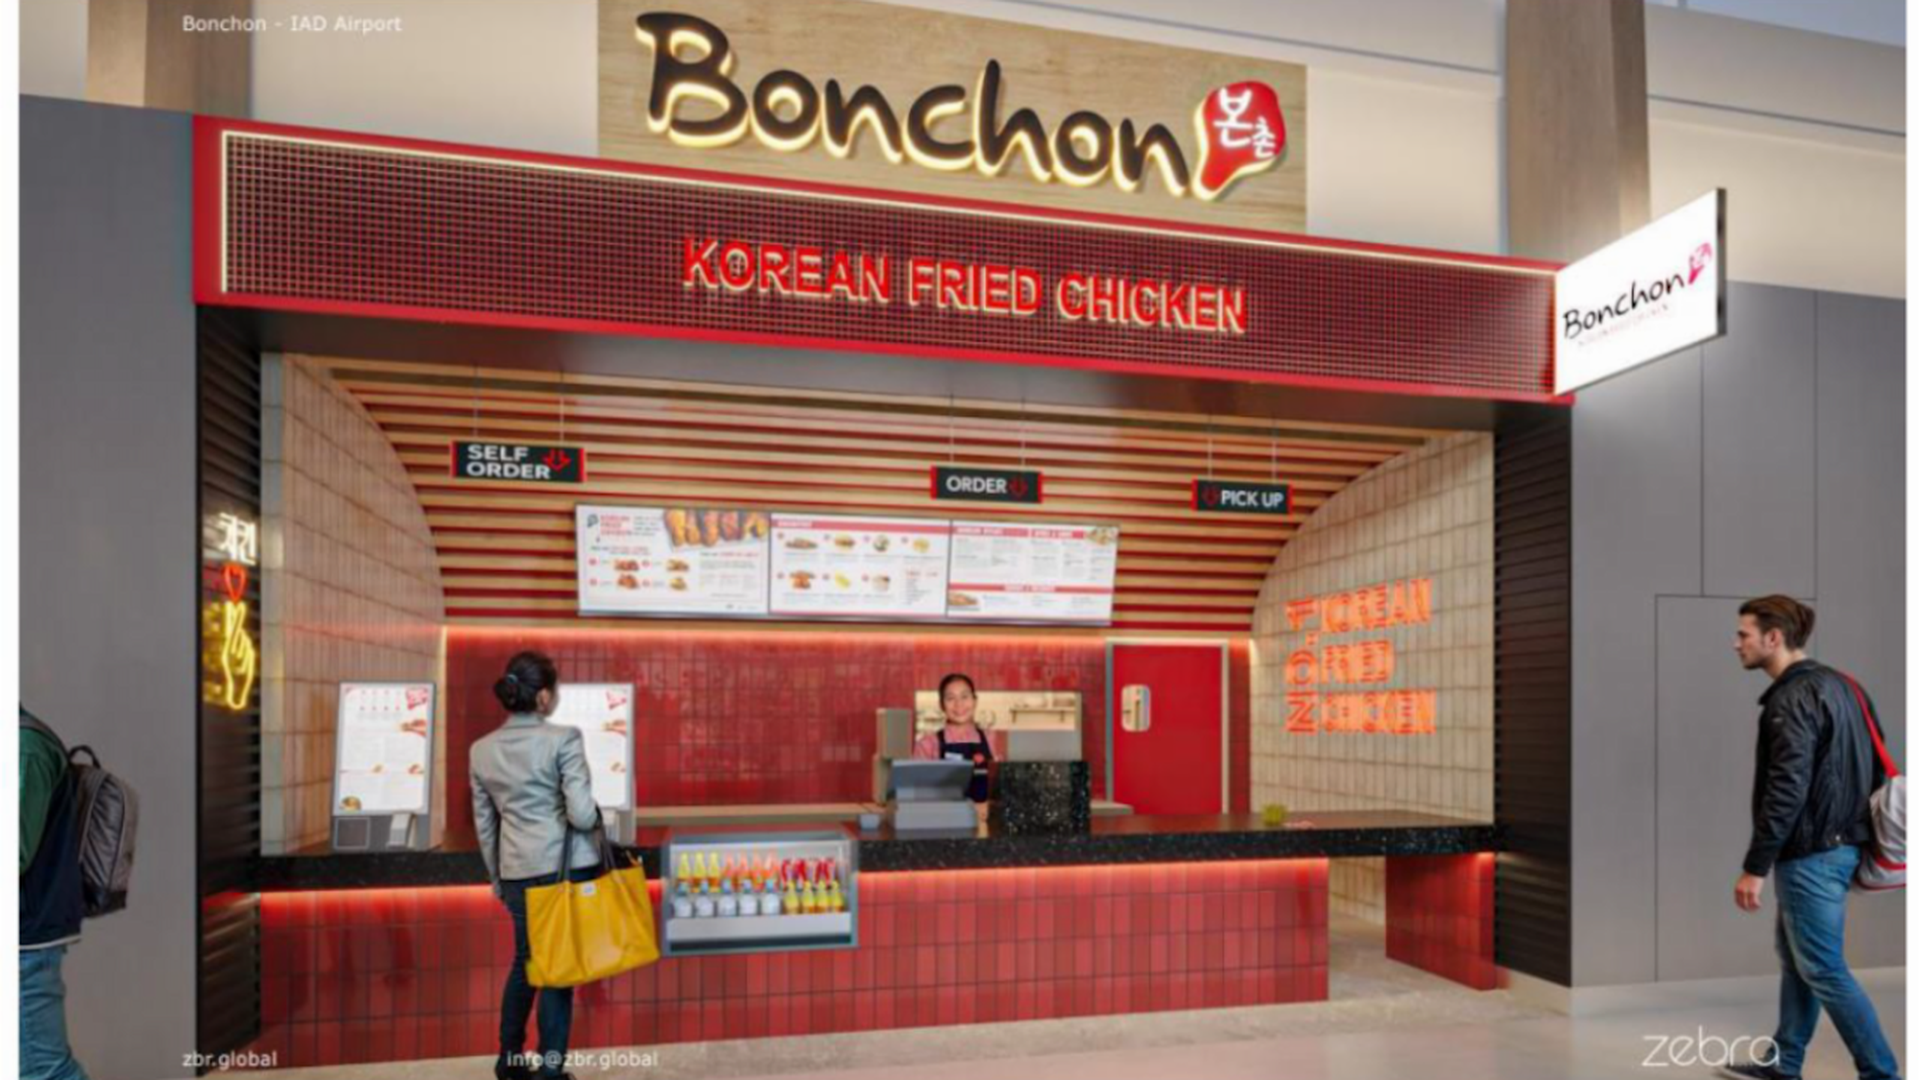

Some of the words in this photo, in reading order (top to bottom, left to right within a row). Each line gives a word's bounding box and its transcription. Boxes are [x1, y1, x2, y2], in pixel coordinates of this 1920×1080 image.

[635, 11, 1189, 196] Bonchon
[1213, 87, 1276, 159] 본촌
[683, 238, 890, 304] KOREAN
[909, 258, 1043, 315] FRIED
[1057, 271, 1246, 334] CHICKEN
[1563, 273, 1685, 340] Bonchon
[466, 461, 551, 479] ORDER
[467, 444, 529, 462] SELF
[946, 475, 1008, 494] ORDER
[1221, 491, 1258, 507] PICK
[1261, 492, 1284, 508] UP
[1322, 578, 1433, 633] KOREAN
[1322, 640, 1394, 685] FRIED
[1322, 688, 1437, 736] CHICKEN
